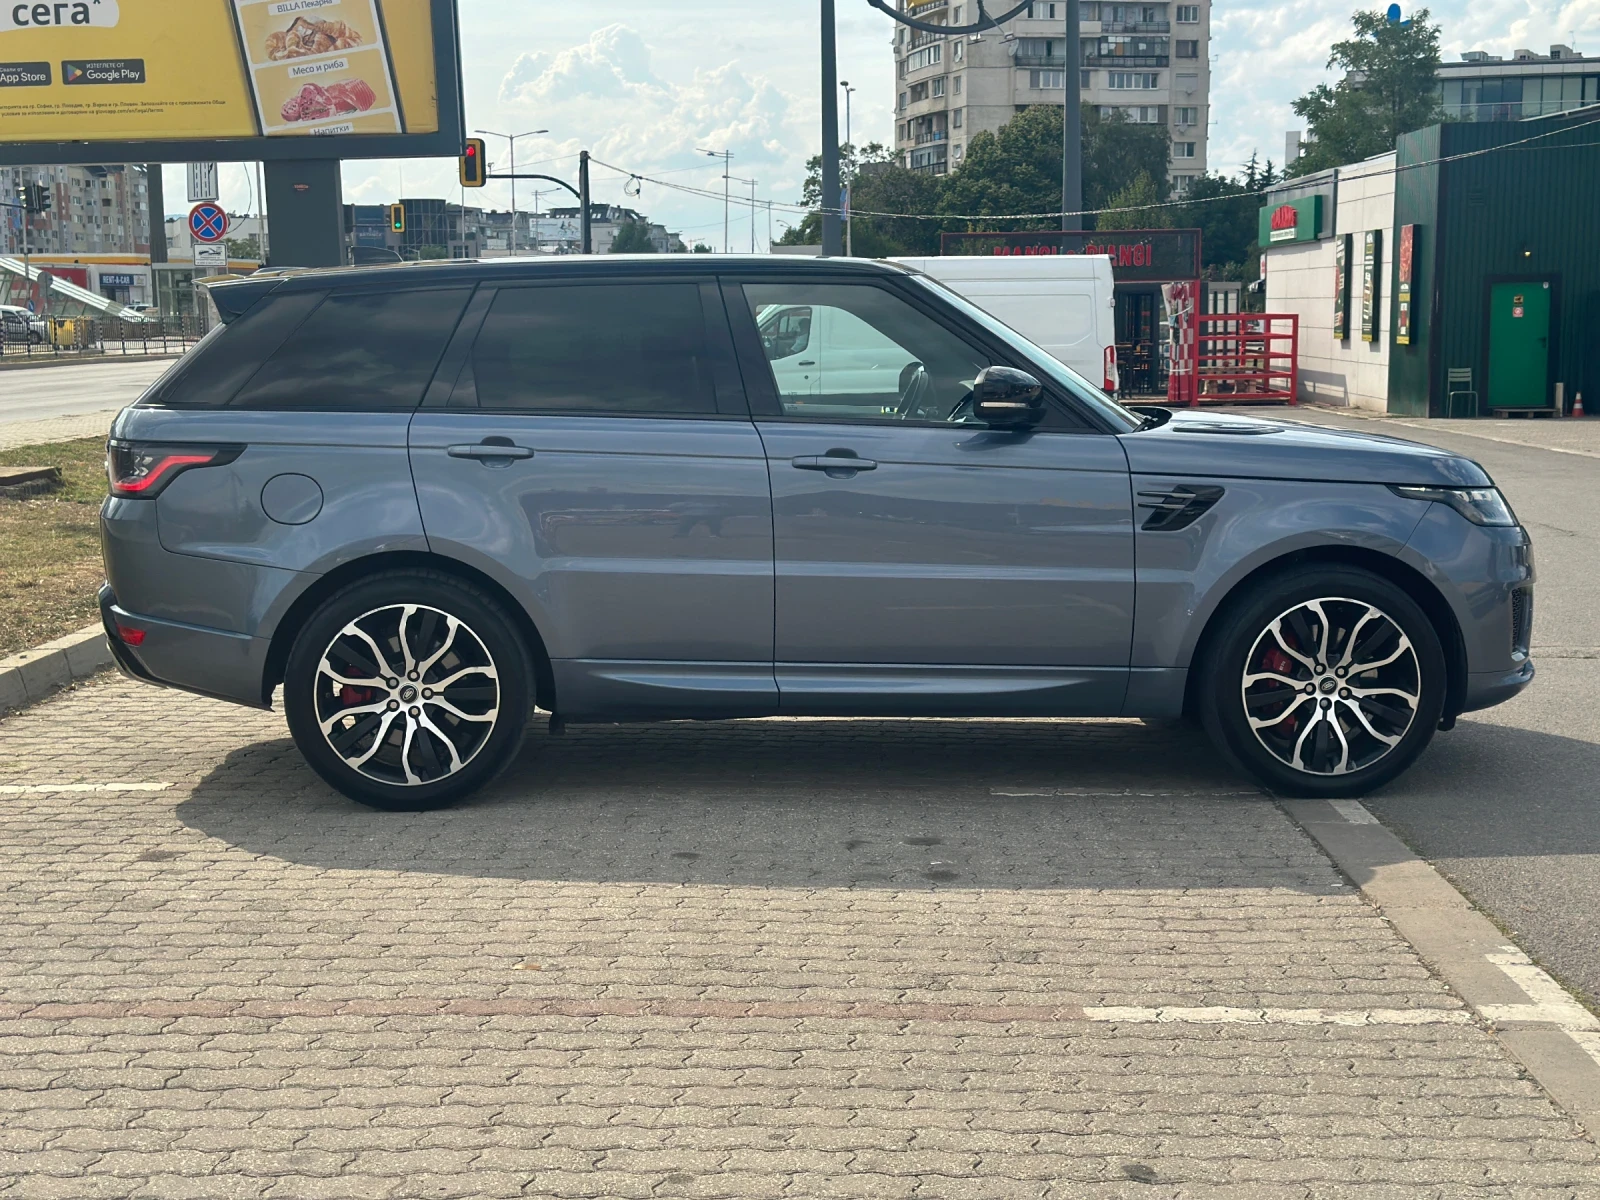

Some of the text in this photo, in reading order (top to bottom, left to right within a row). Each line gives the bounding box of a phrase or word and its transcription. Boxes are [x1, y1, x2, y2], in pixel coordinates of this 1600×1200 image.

[277, 3, 300, 13] BILLA
[292, 61, 344, 76] Месо и риба
[0, 72, 46, 84] App Store
[86, 69, 140, 81] Google Play
[313, 125, 350, 135] Напитки
[102, 275, 131, 284] RENT-A-CAR
